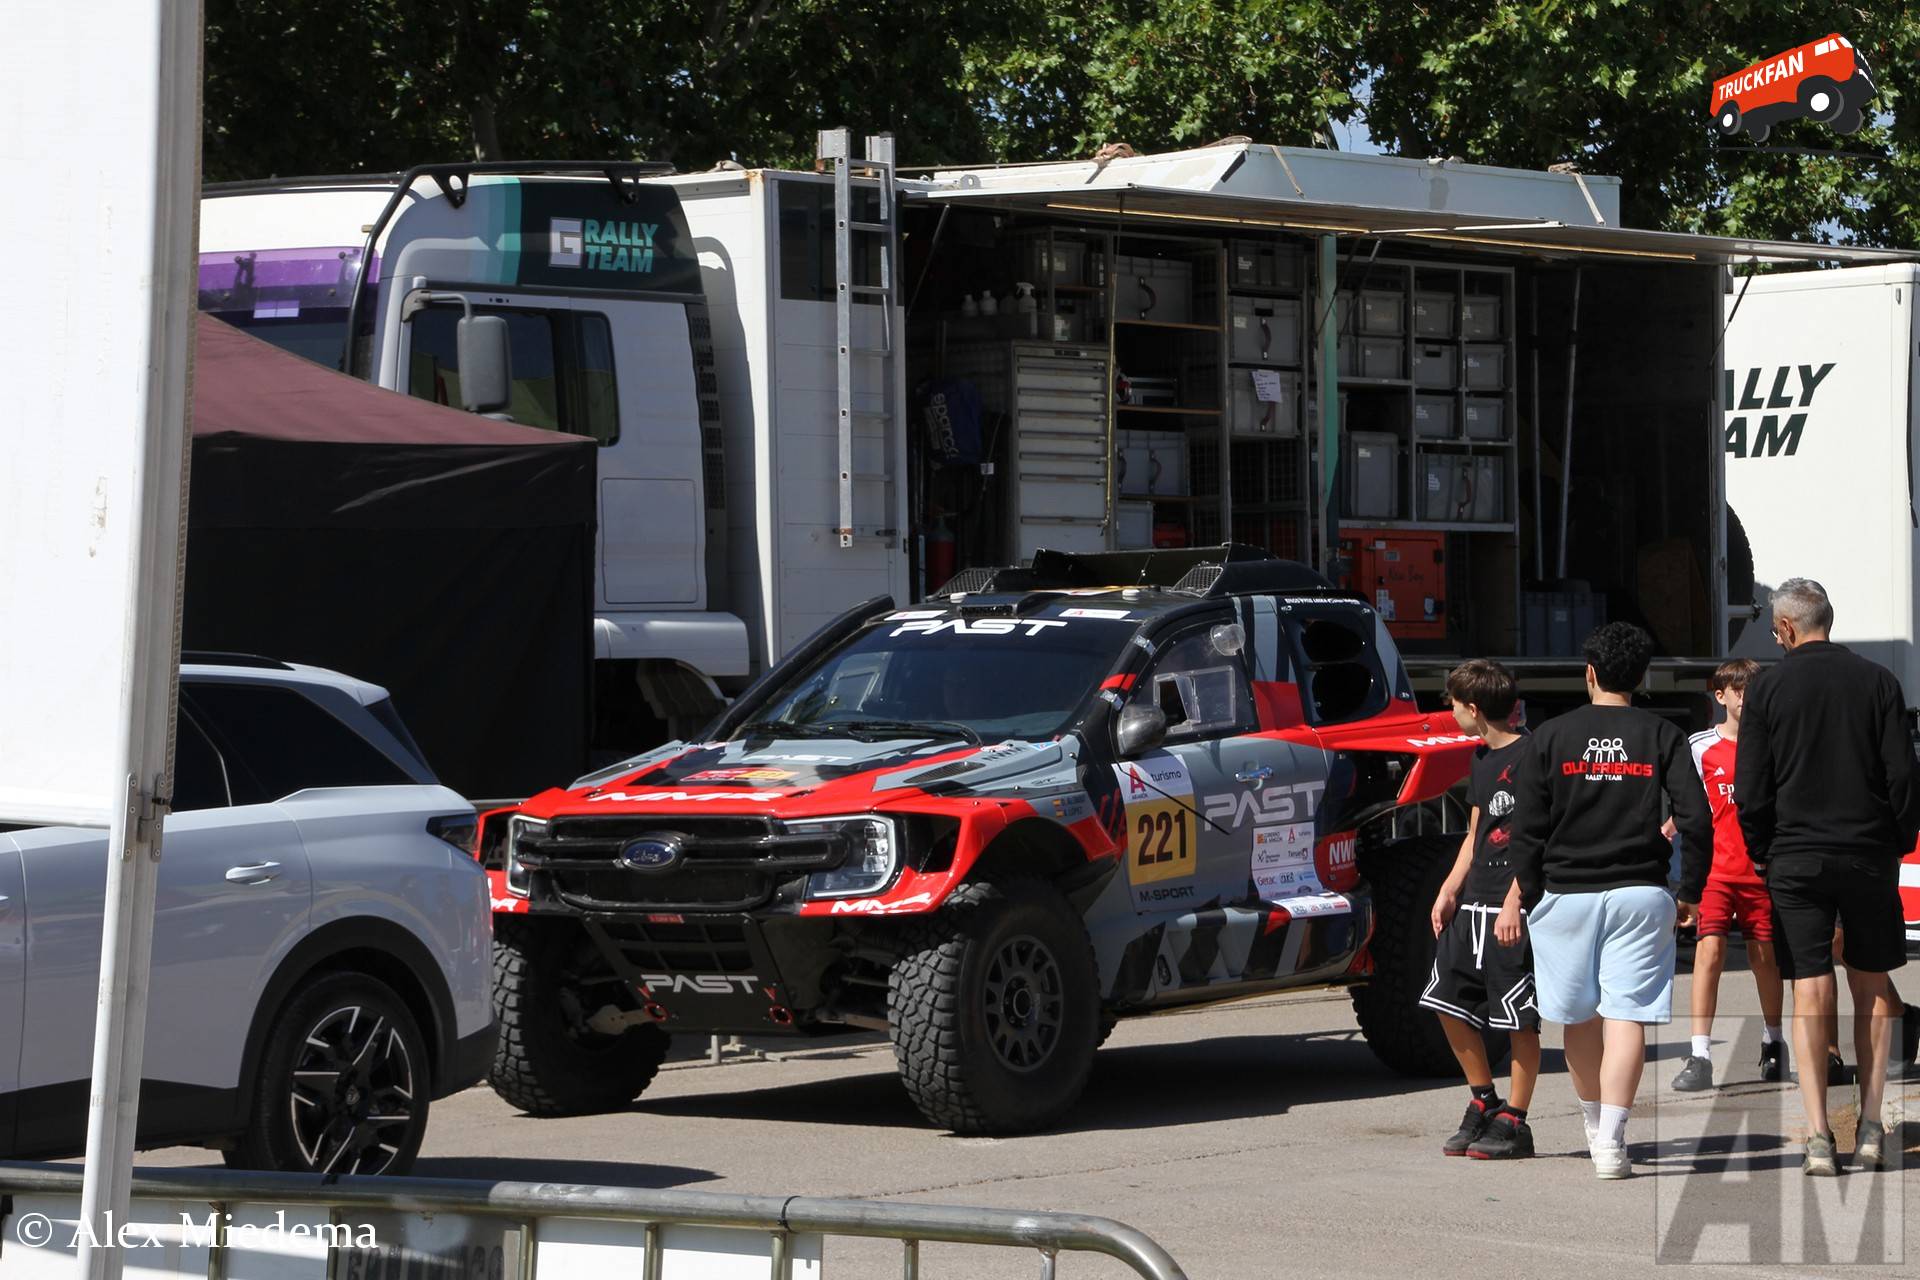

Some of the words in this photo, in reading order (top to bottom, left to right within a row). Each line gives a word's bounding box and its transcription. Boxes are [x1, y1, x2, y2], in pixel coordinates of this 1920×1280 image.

[585, 219, 658, 246] RALLY
[585, 245, 653, 272] TEAM
[889, 618, 1068, 637] PAST
[1151, 771, 1182, 782] turismo
[1563, 760, 1588, 775] OLD
[1592, 762, 1653, 776] FRIENDS
[1204, 780, 1325, 831] PAST
[1137, 809, 1187, 866] 221
[1139, 886, 1195, 903] M-SPORT
[640, 974, 759, 994] PAST
